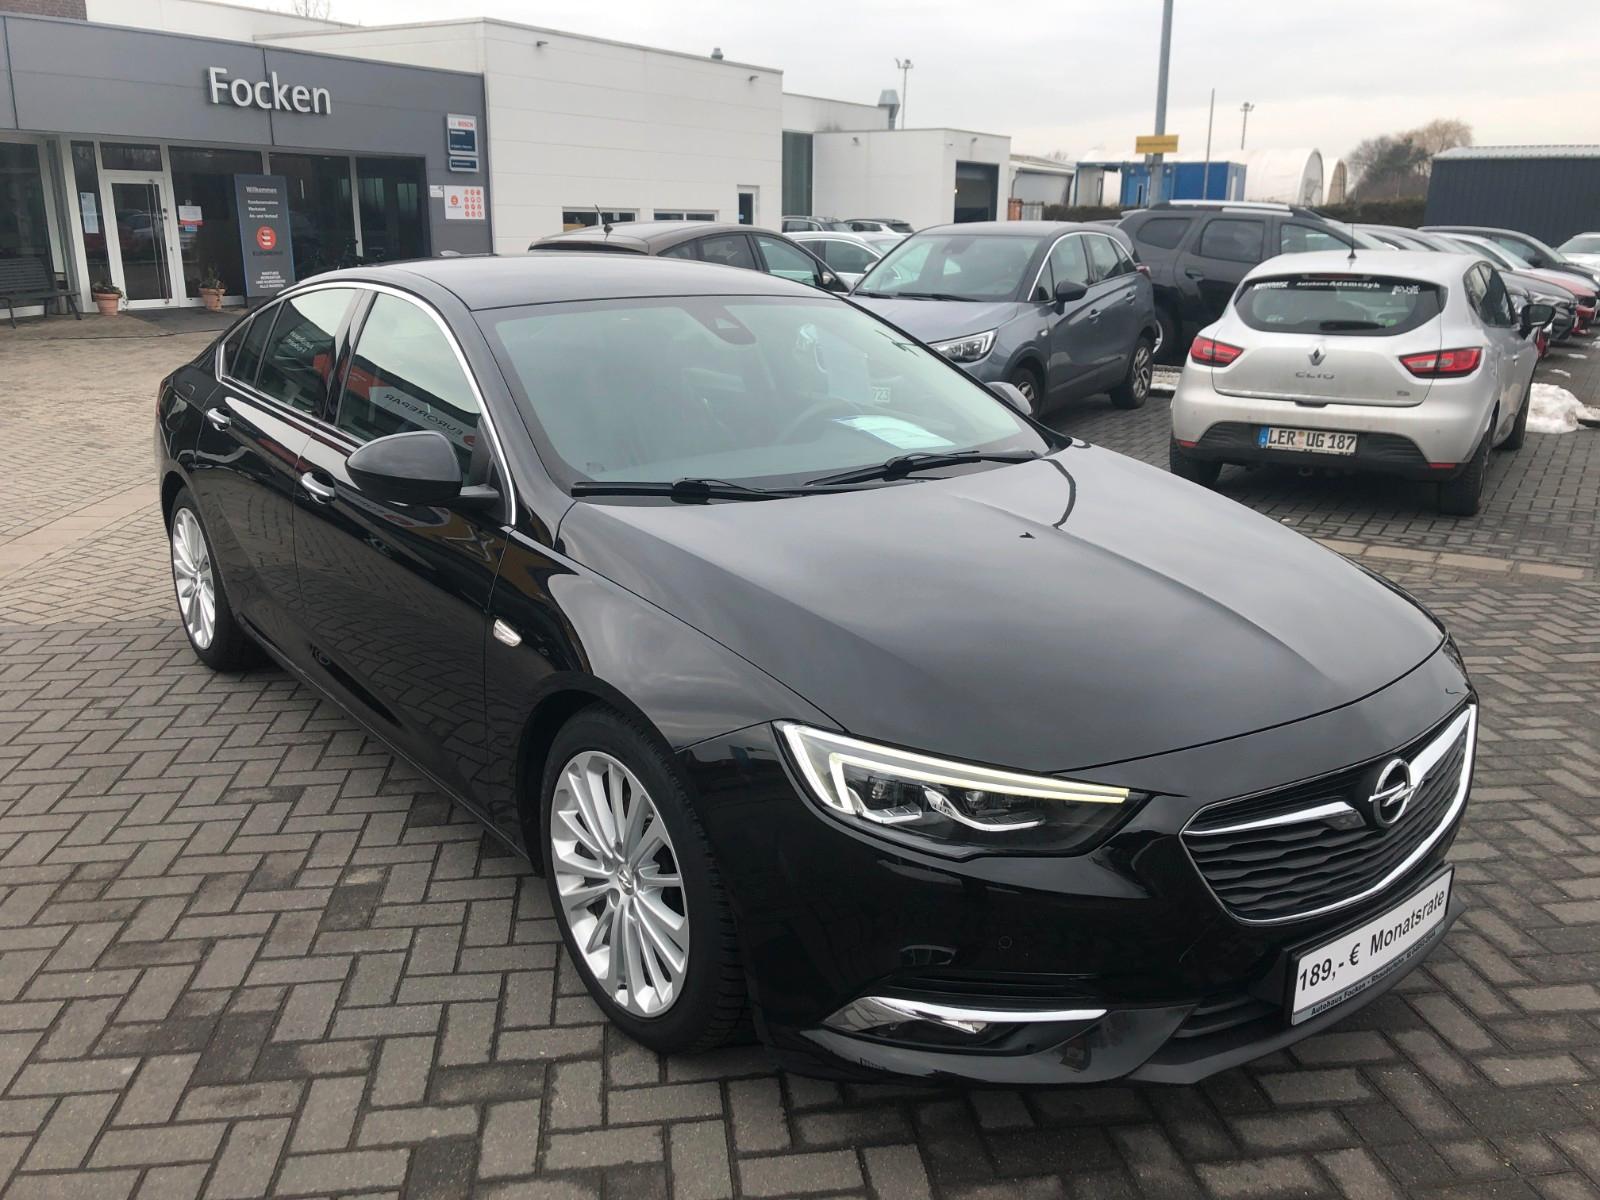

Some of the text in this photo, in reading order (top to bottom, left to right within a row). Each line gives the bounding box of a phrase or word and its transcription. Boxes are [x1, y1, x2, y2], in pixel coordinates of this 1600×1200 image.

[209, 67, 331, 114] Focken
[457, 120, 474, 128] BOSCH
[1329, 280, 1381, 289] Adamczyk
[1295, 371, 1335, 380] CLIO
[1268, 430, 1356, 451] LER UG 187
[1300, 958, 1344, 991] 189,-
[1350, 943, 1361, 966] €
[1370, 890, 1445, 956] Monatsrate
[1311, 995, 1343, 1015] Autohaus
[1344, 980, 1366, 998] Focken
